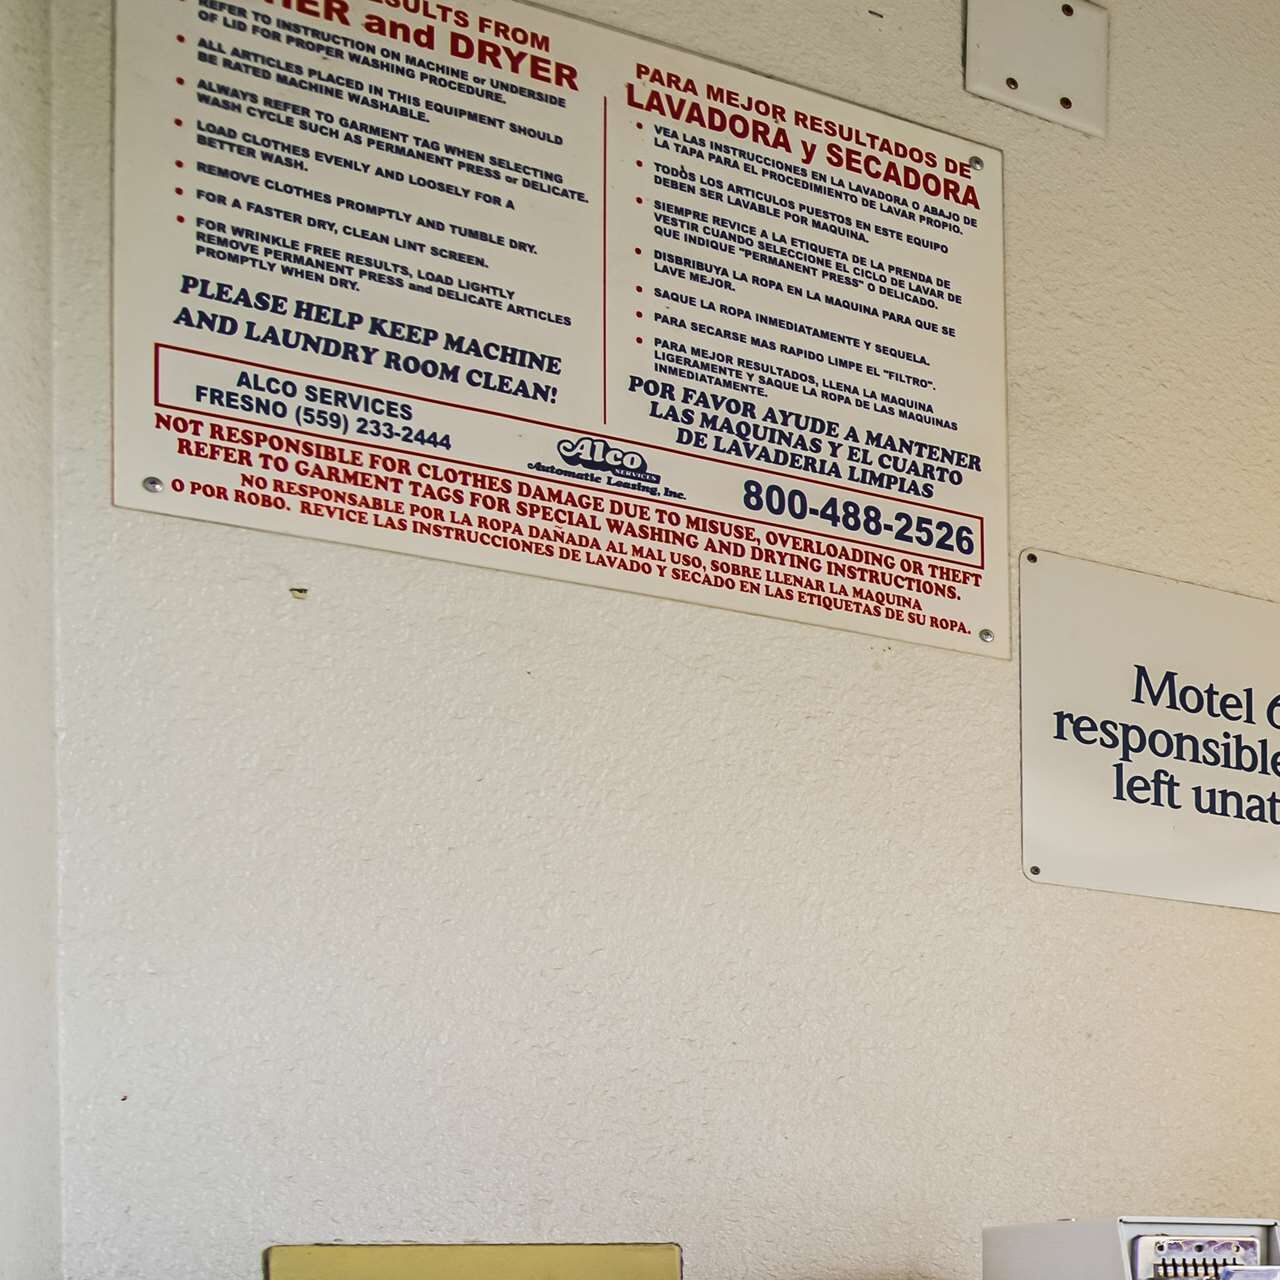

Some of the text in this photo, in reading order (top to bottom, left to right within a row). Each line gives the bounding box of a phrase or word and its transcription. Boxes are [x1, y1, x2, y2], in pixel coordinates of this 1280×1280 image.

[361, 13, 435, 51] and
[450, 31, 579, 92] DRYER
[478, 16, 550, 53] FROM
[196, 134, 308, 172] BETTER WASH.
[624, 82, 981, 210] LAVADORA y SECADORA
[636, 63, 972, 180] PARA MEJOR RESULTADOS DE
[196, 120, 515, 210] LOAD CLOTHES EVENLY AND LOOSELY FOR A
[196, 189, 489, 269] FOR A FASTER DRY, CLEAN LINT SCREEN.
[197, 161, 538, 255] REMOVE CLOTHES PROMPTLY AND TUMBLE DRY.
[172, 307, 558, 404] AND LAUNDRY ROOM CLEAN!
[180, 274, 562, 376] PLEASE HELP KEEP MACHINE
[654, 287, 930, 366] SAQUE LA ROPA INMEDIATAMENTE Y SEQUELA.
[654, 312, 687, 329] PARA
[690, 321, 747, 344] SECARSE
[750, 336, 777, 351] MAS
[779, 343, 824, 363] RAPIDO
[827, 355, 863, 373] LIMPE
[866, 365, 881, 377] EL
[196, 385, 451, 451] FRESNO (559) 233-2444
[236, 371, 413, 421] ALCO SERVICES
[628, 375, 982, 472] POR FAVOR AYUDE A MANTENER
[527, 462, 687, 500] Automatic Leasing, Inc.
[557, 436, 646, 472] Alco
[614, 467, 658, 482] SERVICES
[649, 400, 963, 486] LAS MAQUINAS Y EL CUARTO
[675, 427, 934, 499] DE LAVADERIA LIMPIAS
[154, 412, 983, 587] NOT RESPONSIBLE FOR CLOTHES DAMAGE DUE TO MISUSE, OVERLOADING OR THEFT
[177, 437, 961, 601] REFER TO GARMENT TAGS FOR SPECIAL WASHING AND DRYING INSTRUCTIONS.
[743, 479, 974, 555] 800-488-2526
[1131, 663, 1257, 725] Motel
[1112, 762, 1182, 810] left
